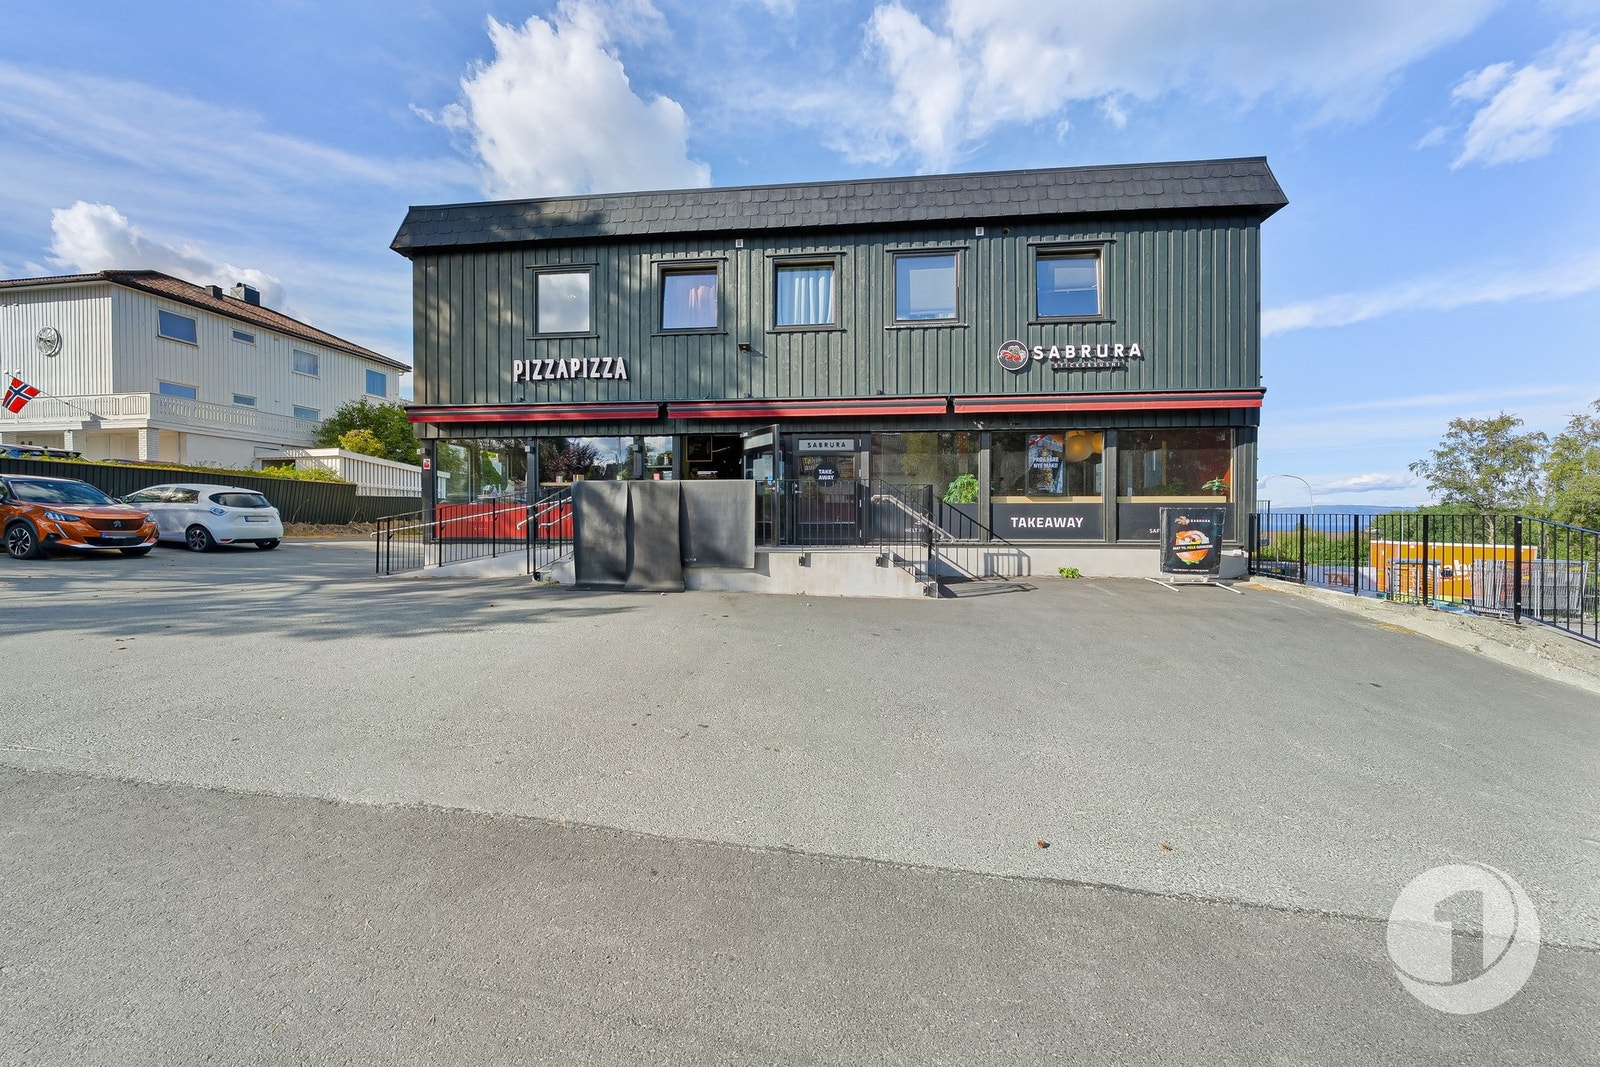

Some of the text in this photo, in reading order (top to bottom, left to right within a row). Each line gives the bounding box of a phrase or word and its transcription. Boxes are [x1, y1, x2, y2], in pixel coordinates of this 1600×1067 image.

[1033, 343, 1142, 360] SABRURA
[513, 357, 628, 382] PIZZAPIZZA
[1010, 517, 1084, 528] TAKEAWAY
